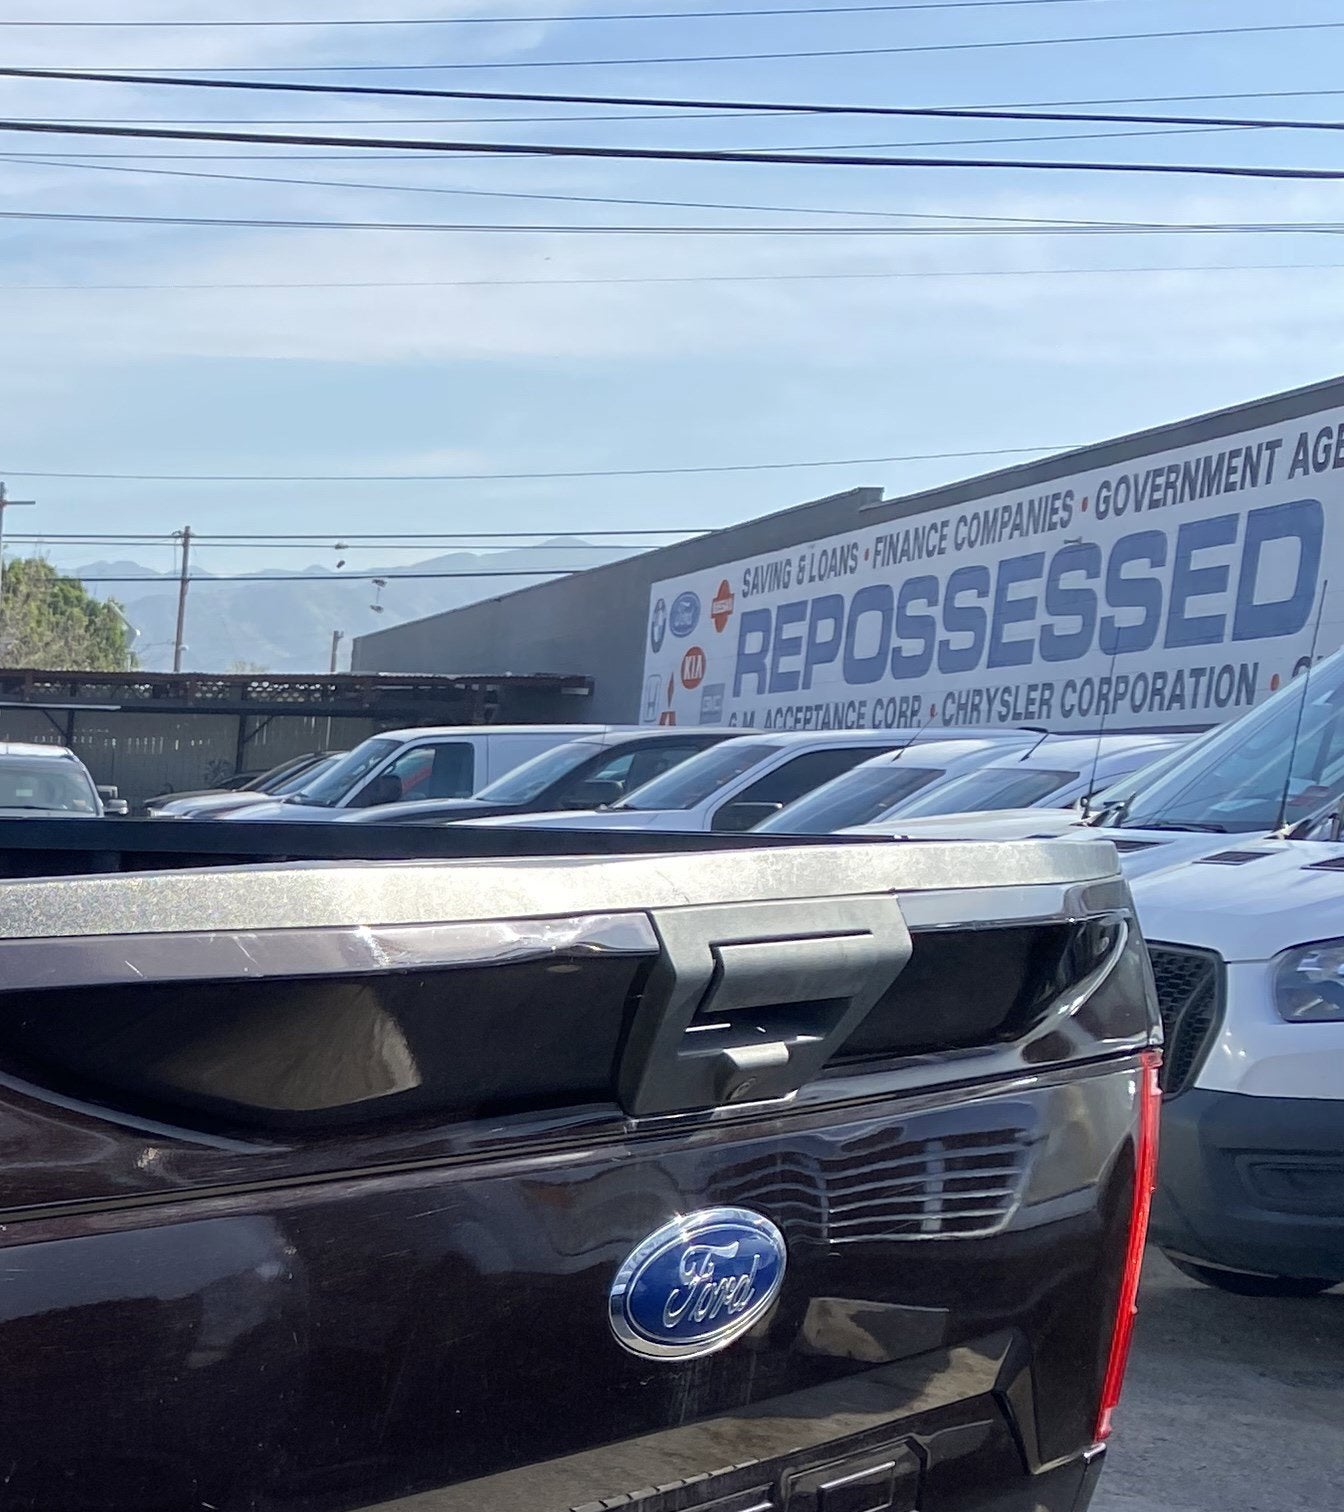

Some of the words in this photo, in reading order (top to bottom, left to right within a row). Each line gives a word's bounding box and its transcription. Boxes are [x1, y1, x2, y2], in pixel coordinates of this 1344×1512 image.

[741, 558, 793, 598] SAVING
[796, 554, 806, 586] &
[808, 541, 859, 583] LOANS
[872, 519, 949, 570] FINANCE
[953, 489, 1075, 551] COMPANIES
[1094, 438, 1283, 521] GOVERNMENT
[733, 498, 1325, 697] REPOSSESSED
[941, 682, 1055, 728] CHRYSLER
[1060, 662, 1259, 720] CORPORATION
[664, 1240, 761, 1328] Ford
